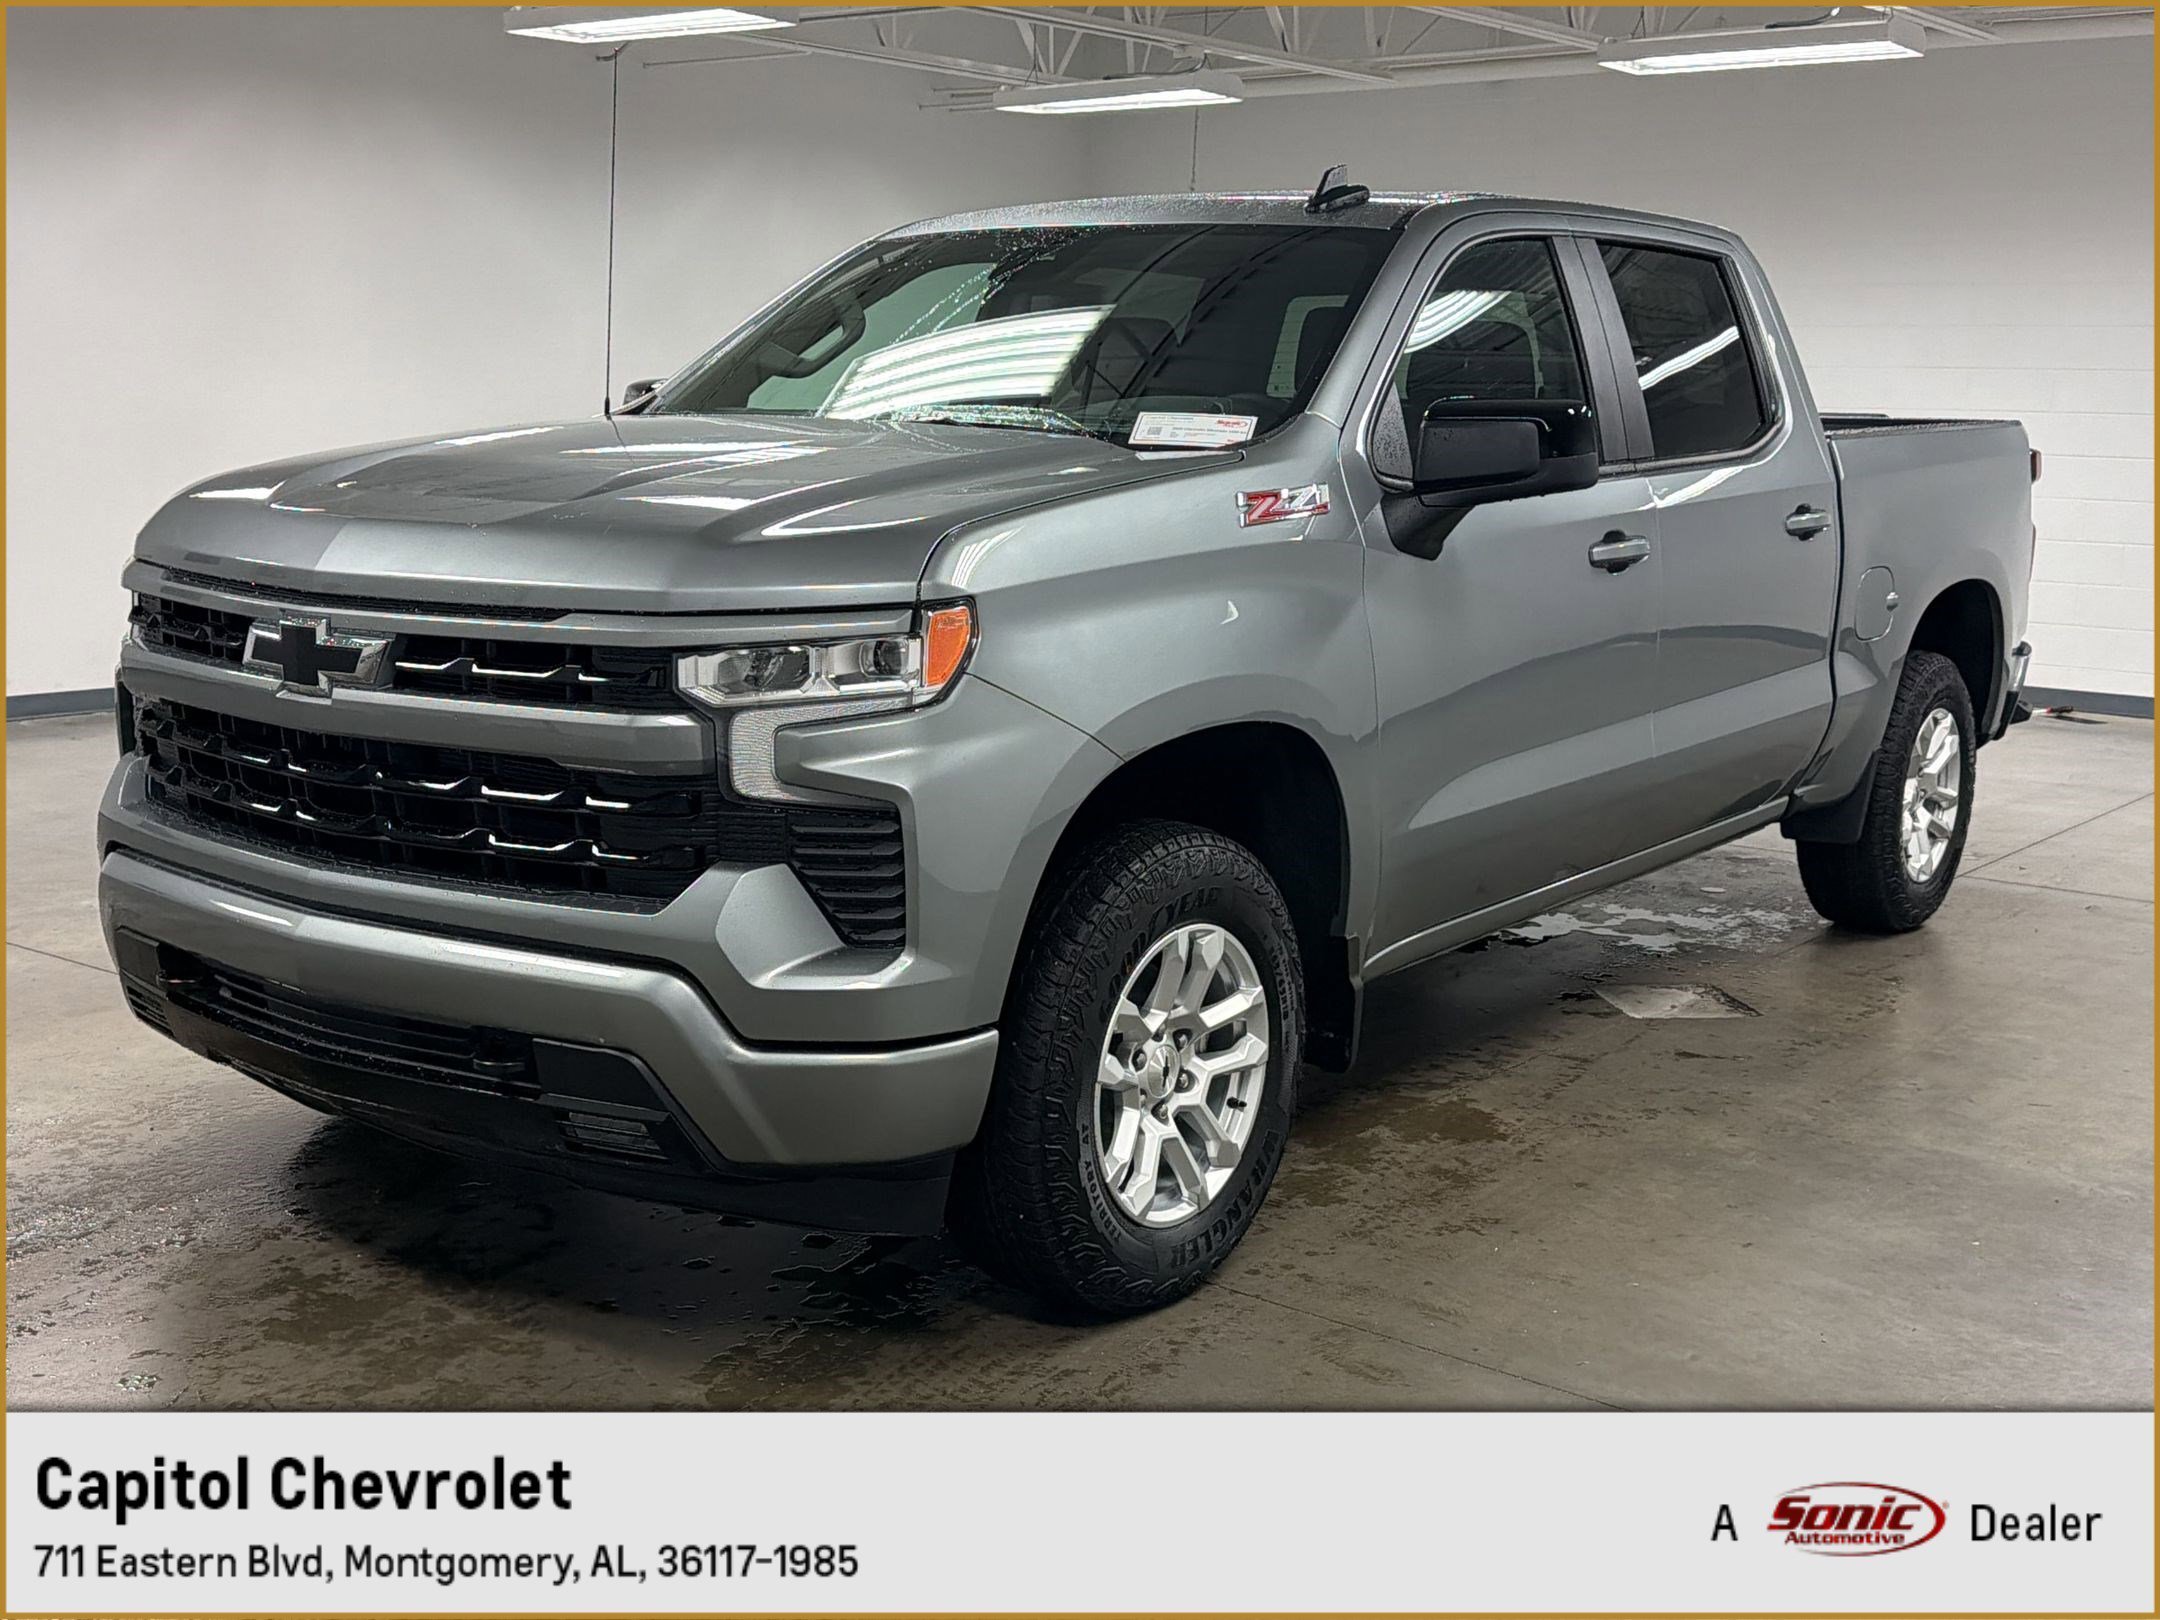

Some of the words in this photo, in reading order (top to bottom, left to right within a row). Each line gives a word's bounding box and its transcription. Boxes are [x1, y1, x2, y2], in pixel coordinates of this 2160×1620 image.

[1236, 482, 1330, 528] Z71
[1084, 1159, 1122, 1243] TERRITORY
[1171, 1129, 1280, 1268] WRANGLER
